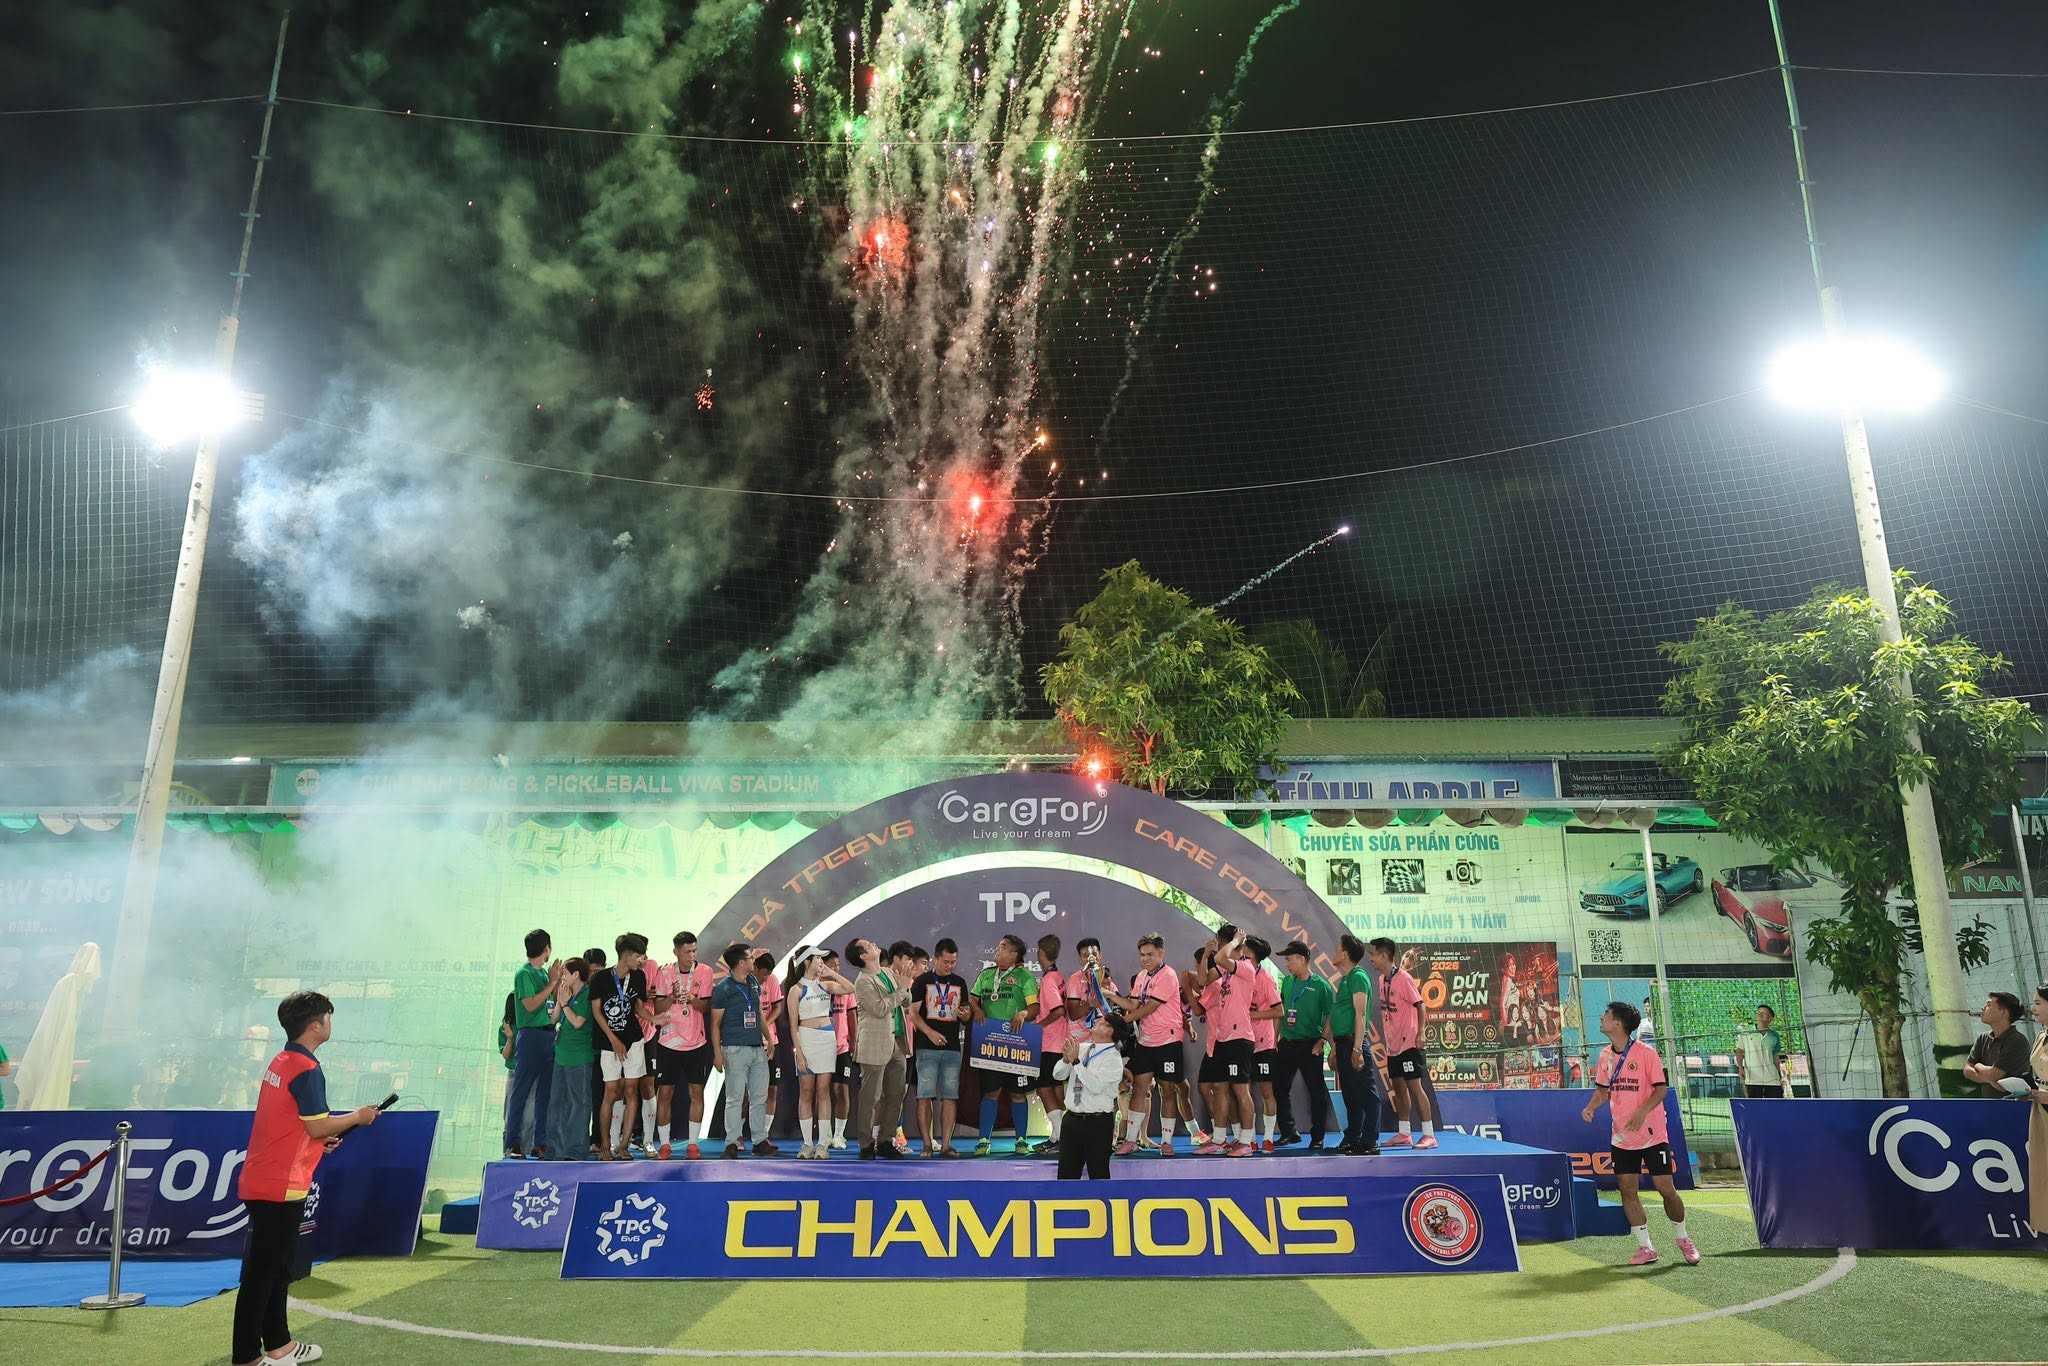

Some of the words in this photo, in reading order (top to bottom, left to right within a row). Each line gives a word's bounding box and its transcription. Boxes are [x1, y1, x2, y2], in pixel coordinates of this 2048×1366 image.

[523, 776, 539, 793] &
[545, 775, 673, 793] PICKLEBALL
[678, 775, 723, 793] VIVA
[729, 775, 820, 793] STADIUM
[1273, 771, 1373, 800] TÍNH
[940, 793, 1099, 826] CareFor
[973, 829, 998, 839] Live
[1003, 830, 1029, 841] your
[1034, 829, 1071, 838] dream
[1299, 832, 1363, 852] CHUYÊN
[1368, 827, 1401, 851] SỬA
[1405, 828, 1450, 851] PHẦN
[1455, 831, 1500, 851] CỨNG
[1134, 818, 1219, 871] CARE
[1218, 862, 1279, 916] FOR
[740, 896, 785, 941] ĐÁ
[782, 819, 916, 894] TPG6V6
[978, 891, 1057, 922] TPG
[1445, 896, 1466, 904] APPLE
[1466, 896, 1487, 904] WATCH
[1515, 895, 1541, 903] AIRPODS
[1345, 913, 1371, 930] PIN
[1376, 908, 1407, 930] BẢO
[1411, 910, 1453, 930] HÀNH
[1457, 913, 1465, 929] 1
[1413, 971, 1447, 1009] Ô
[1450, 990, 1489, 1009] CẠN
[981, 1043, 995, 1058] ĐỘI
[997, 1045, 1009, 1058] VÔ
[1011, 1048, 1031, 1063] ĐỊCH
[1164, 1061, 1176, 1074] 68
[1228, 1064, 1239, 1076] 10
[1258, 1063, 1270, 1075] 79
[1402, 1061, 1415, 1073] 66
[1017, 1075, 1028, 1087] 99
[1457, 1073, 1476, 1083] CẠN
[1443, 1124, 1503, 1142] V6
[1660, 1150, 1667, 1165] 7
[1884, 1118, 2030, 1193] Ca
[524, 1196, 549, 1207] TPG
[75, 1221, 171, 1247] dram
[614, 1220, 652, 1235] TPG
[724, 1196, 1357, 1259] CHAMPIONS
